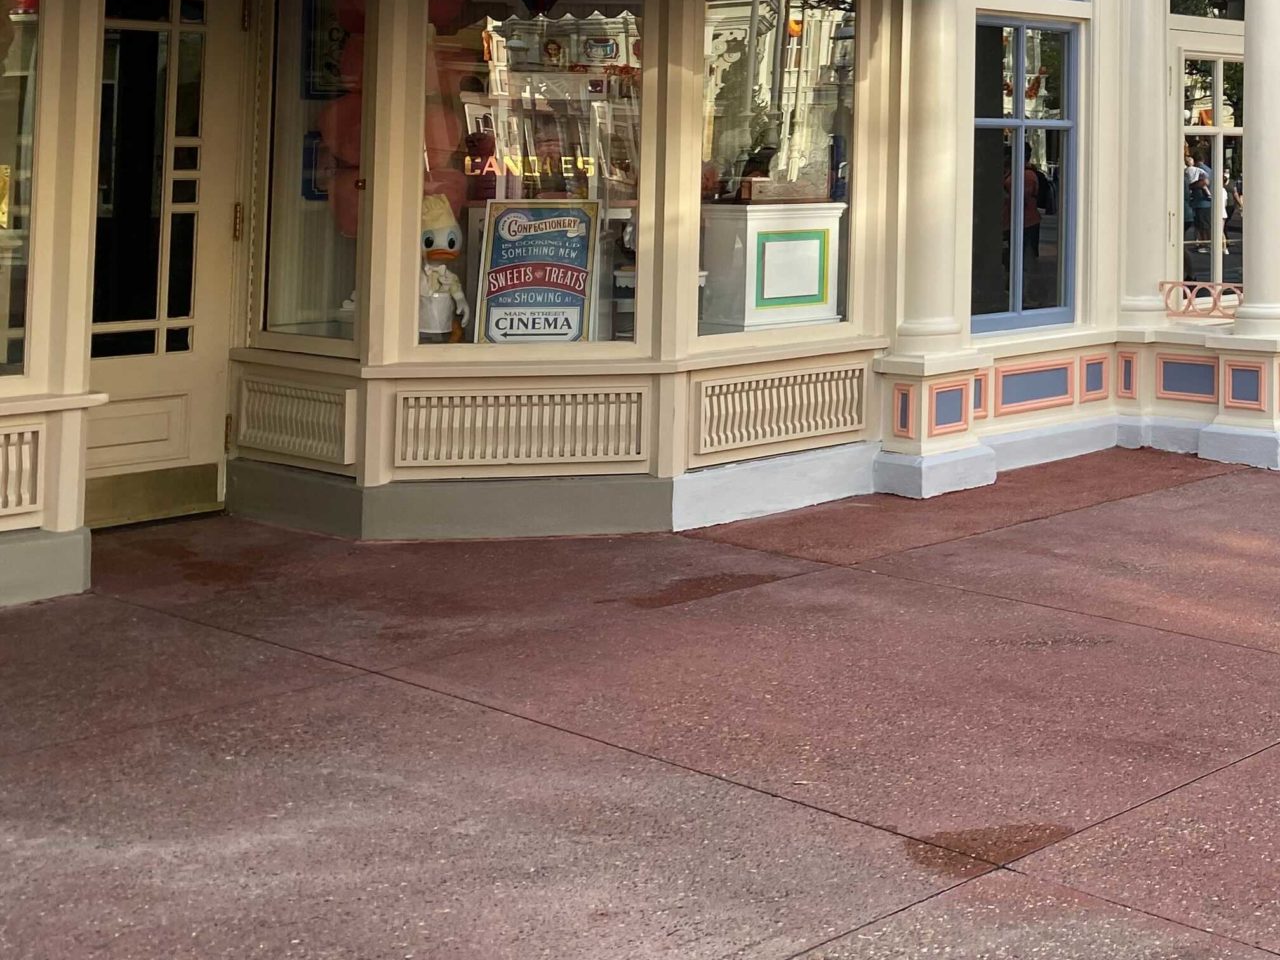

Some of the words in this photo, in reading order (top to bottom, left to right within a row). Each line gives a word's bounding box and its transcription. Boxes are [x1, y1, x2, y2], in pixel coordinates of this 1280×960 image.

[508, 218, 578, 237] CONFECTIONERY
[502, 246, 555, 259] SOMETHING
[558, 247, 578, 259] NEW
[489, 266, 533, 291] SWEETS
[545, 266, 587, 290] TREATS
[514, 292, 561, 303] SHOWING
[495, 317, 573, 330] CINEMA
